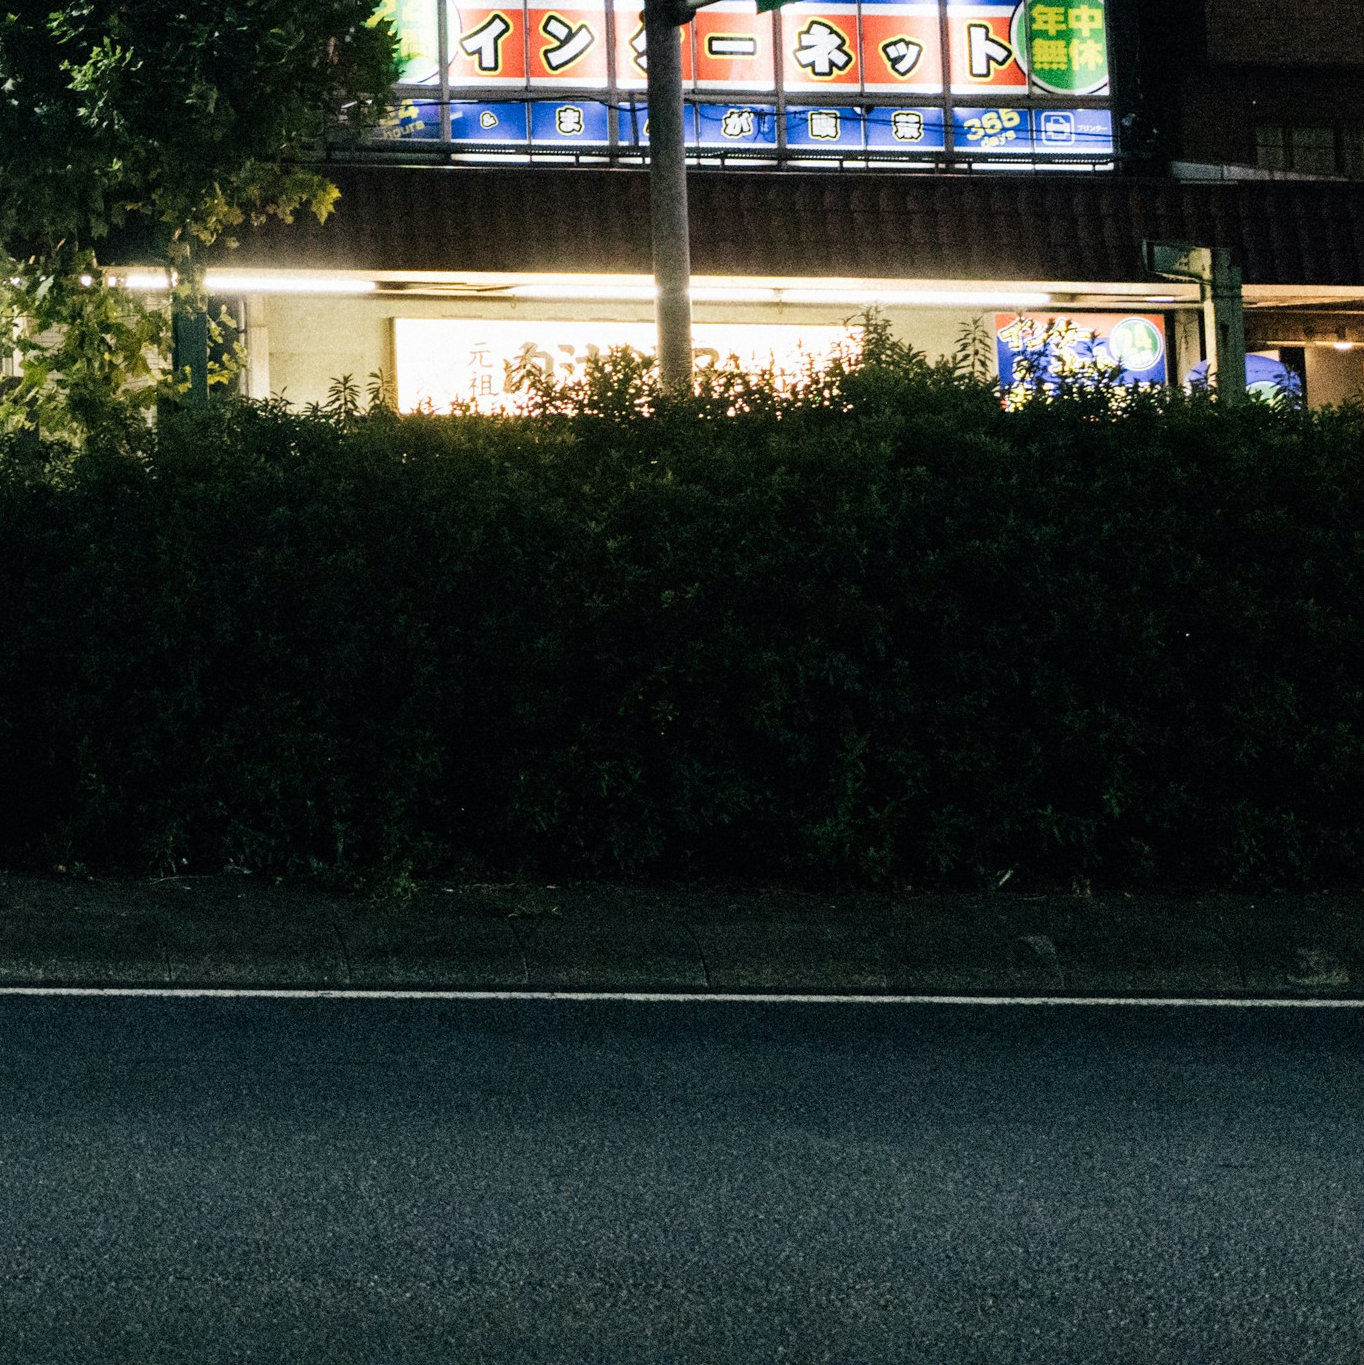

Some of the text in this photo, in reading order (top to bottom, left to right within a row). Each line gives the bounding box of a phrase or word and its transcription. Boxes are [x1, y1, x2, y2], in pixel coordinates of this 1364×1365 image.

[1030, 4, 1105, 36] 年中
[1030, 38, 1105, 72] 無休
[558, 107, 922, 139] まが喫茶
[964, 109, 1021, 141] 365
[1076, 124, 1109, 133] プリンター
[980, 130, 1017, 149] days
[467, 341, 499, 398] 元祖
